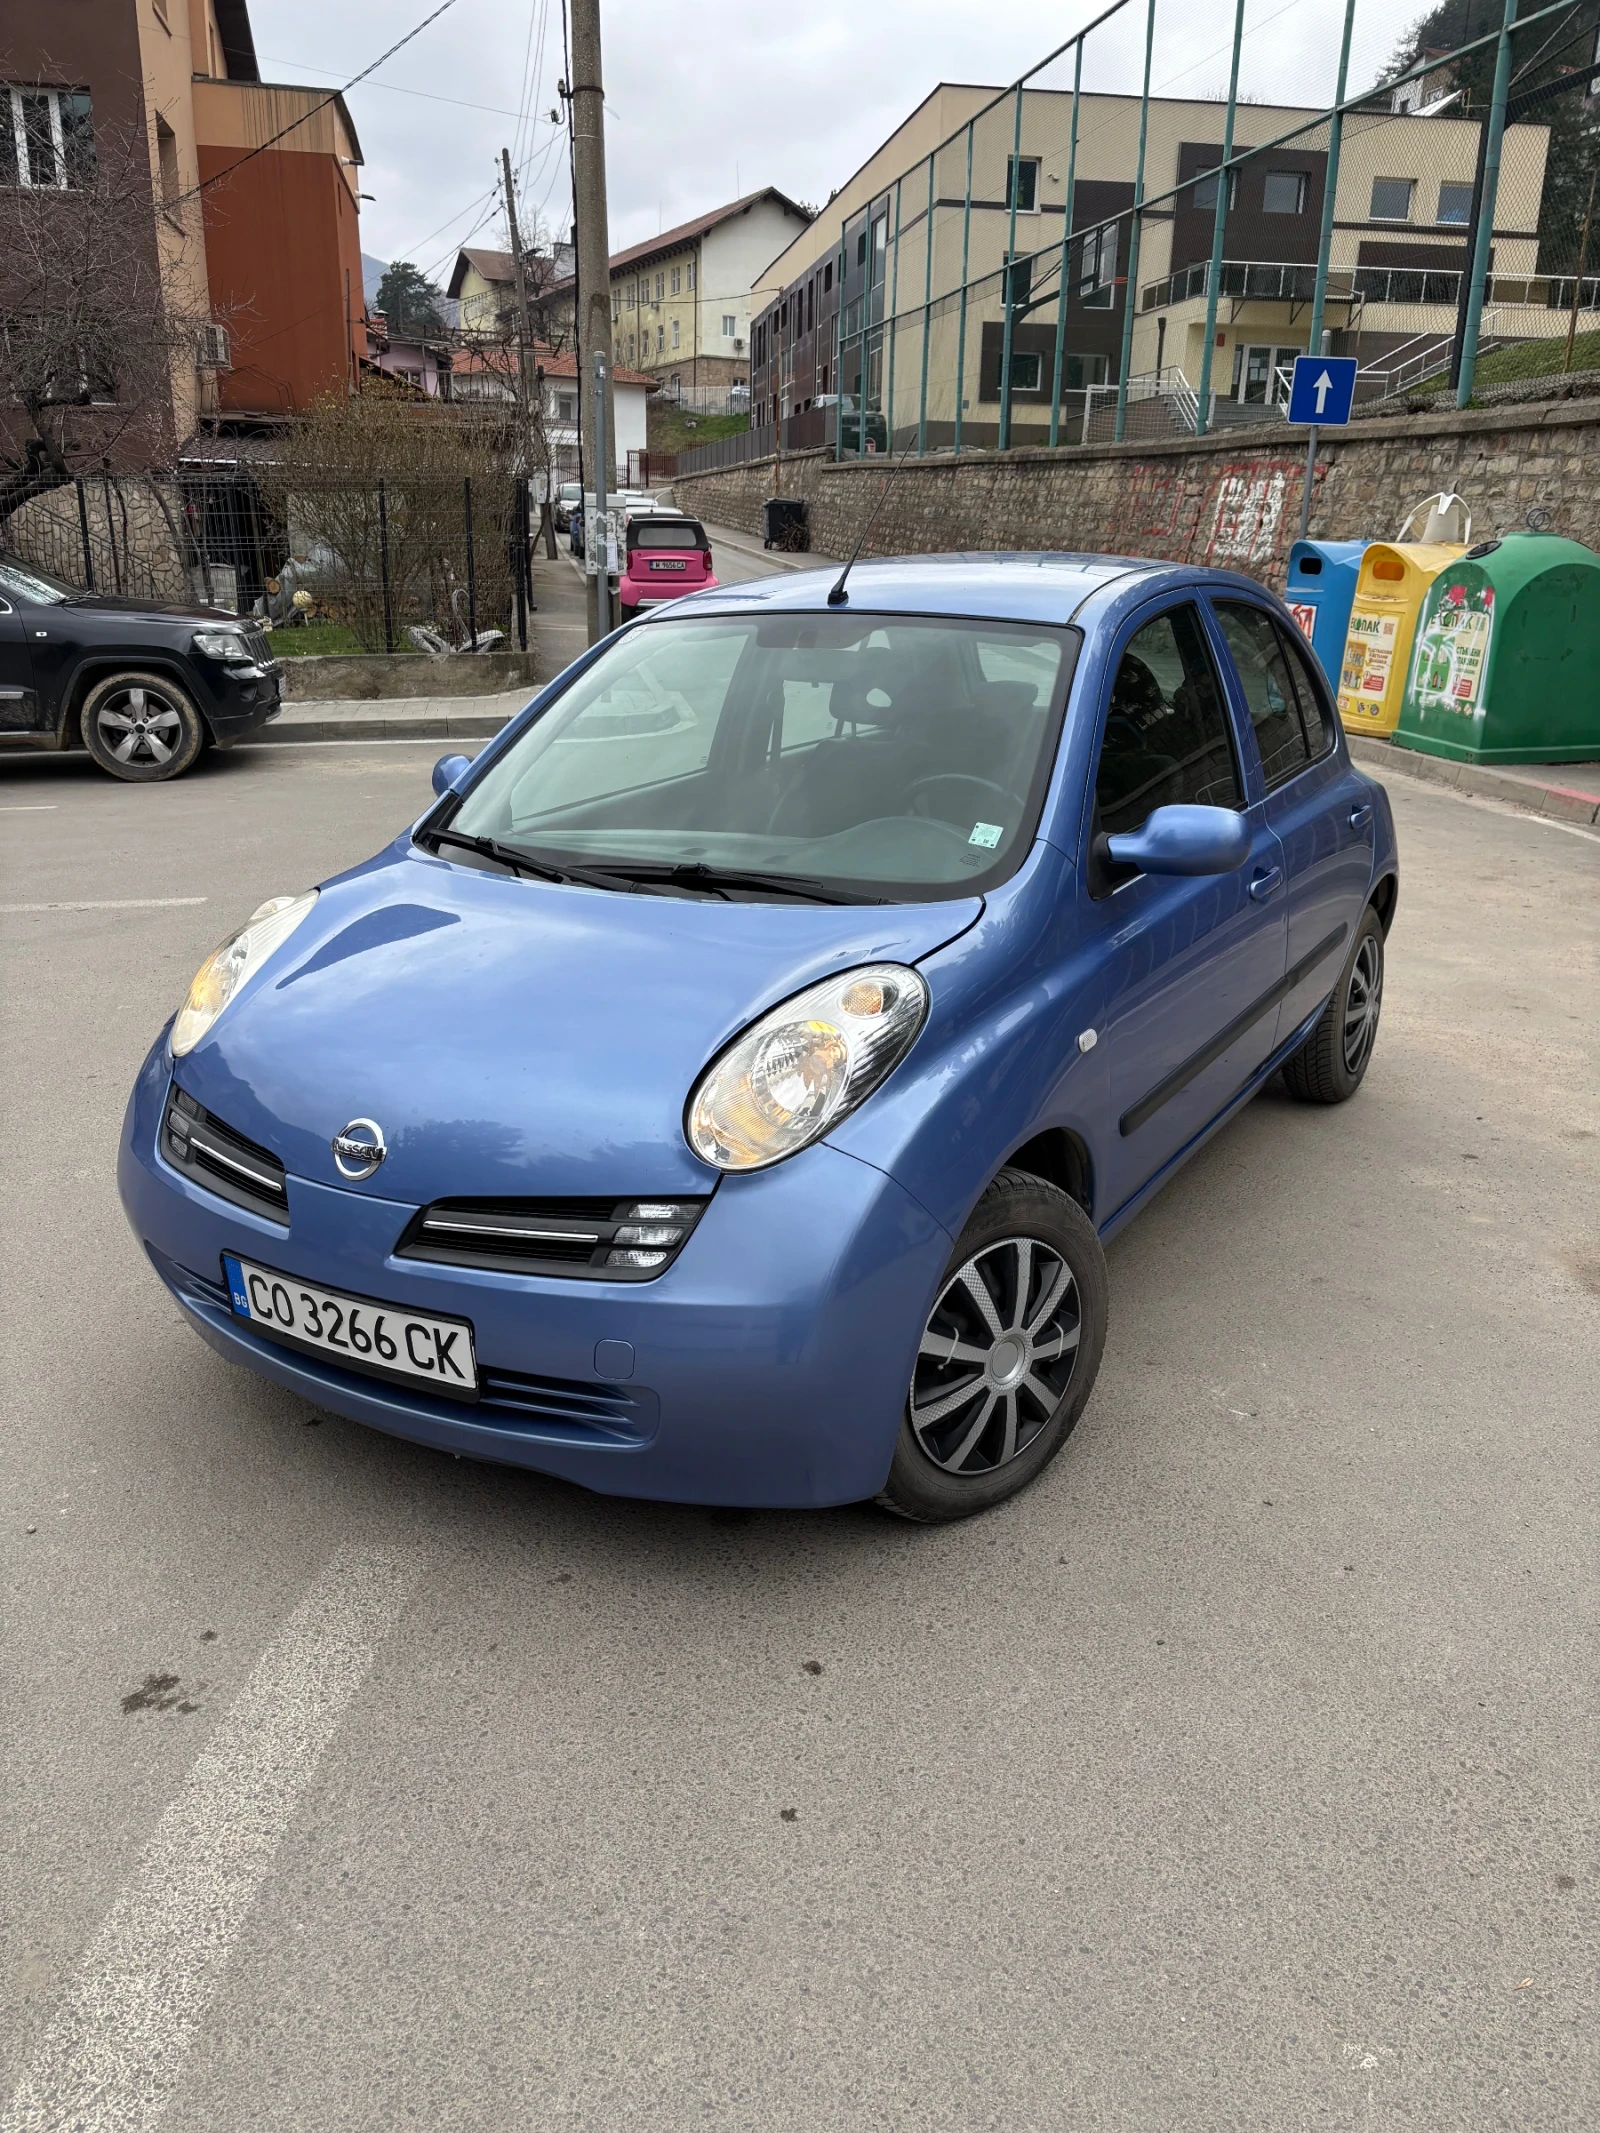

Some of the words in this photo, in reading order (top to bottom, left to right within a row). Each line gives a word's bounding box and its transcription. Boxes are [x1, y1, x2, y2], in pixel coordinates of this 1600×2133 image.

[332, 1138, 384, 1161] NISSAN
[233, 1292, 248, 1308] BG
[248, 1273, 295, 1327] CO
[300, 1293, 398, 1361] 3266
[405, 1323, 467, 1379] CK
